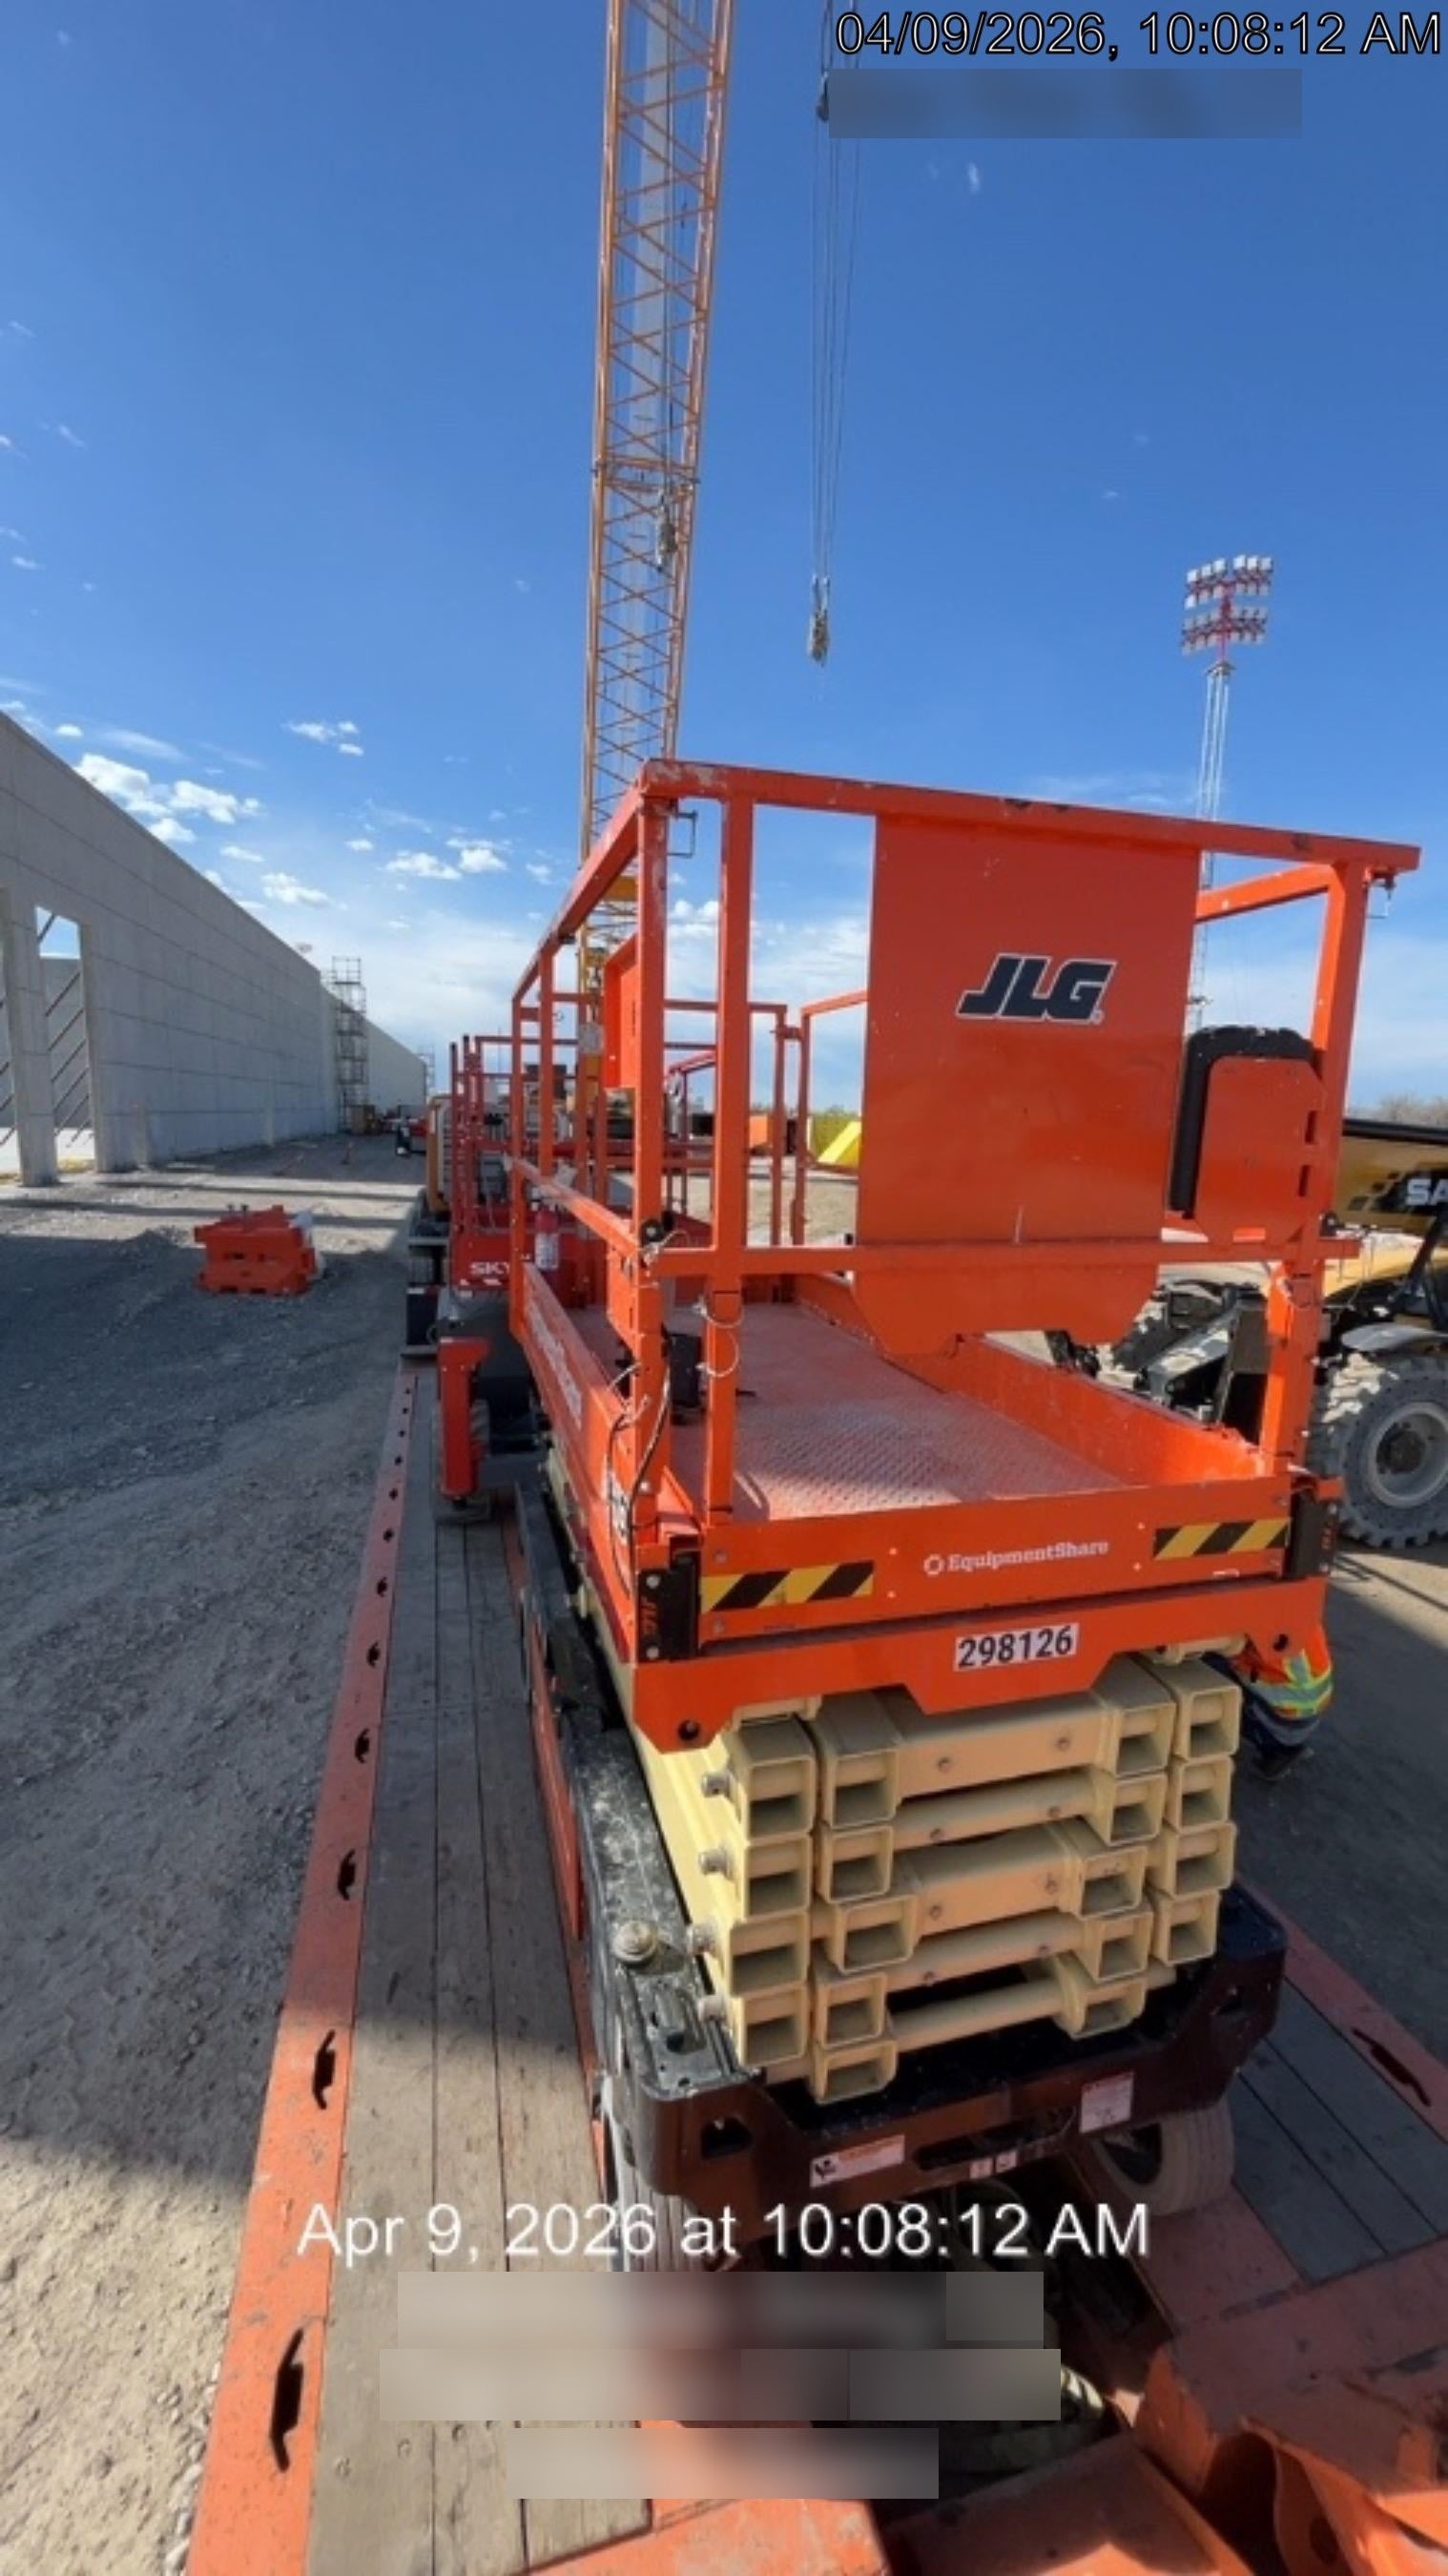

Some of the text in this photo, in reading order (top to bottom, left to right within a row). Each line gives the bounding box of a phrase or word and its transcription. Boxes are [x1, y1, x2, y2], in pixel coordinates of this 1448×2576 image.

[956, 952, 1118, 1025] JLG
[947, 1541, 1108, 1572] EquipmentShare
[958, 1625, 1072, 1669] 298126
